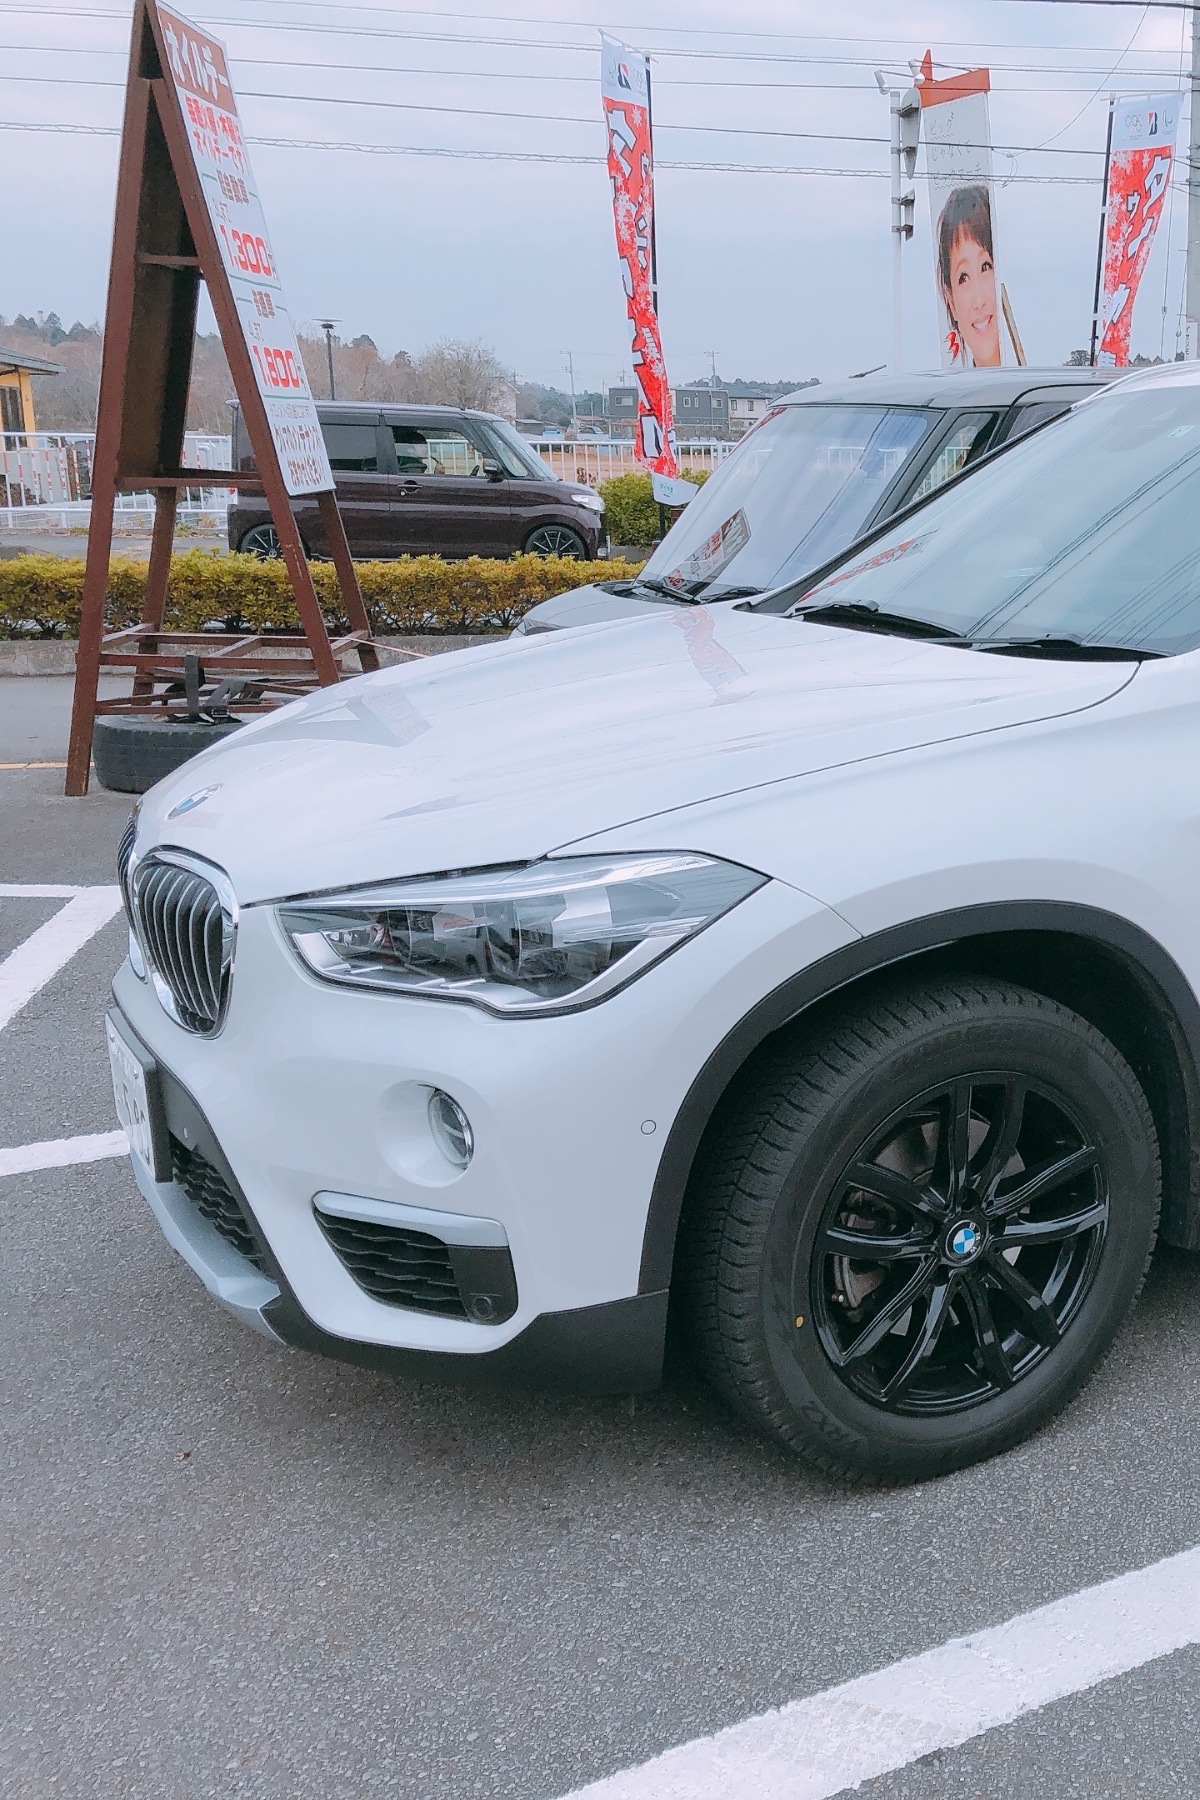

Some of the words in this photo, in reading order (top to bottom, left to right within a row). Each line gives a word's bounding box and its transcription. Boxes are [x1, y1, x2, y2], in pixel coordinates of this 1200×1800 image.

[164, 22, 229, 102] オイルデー
